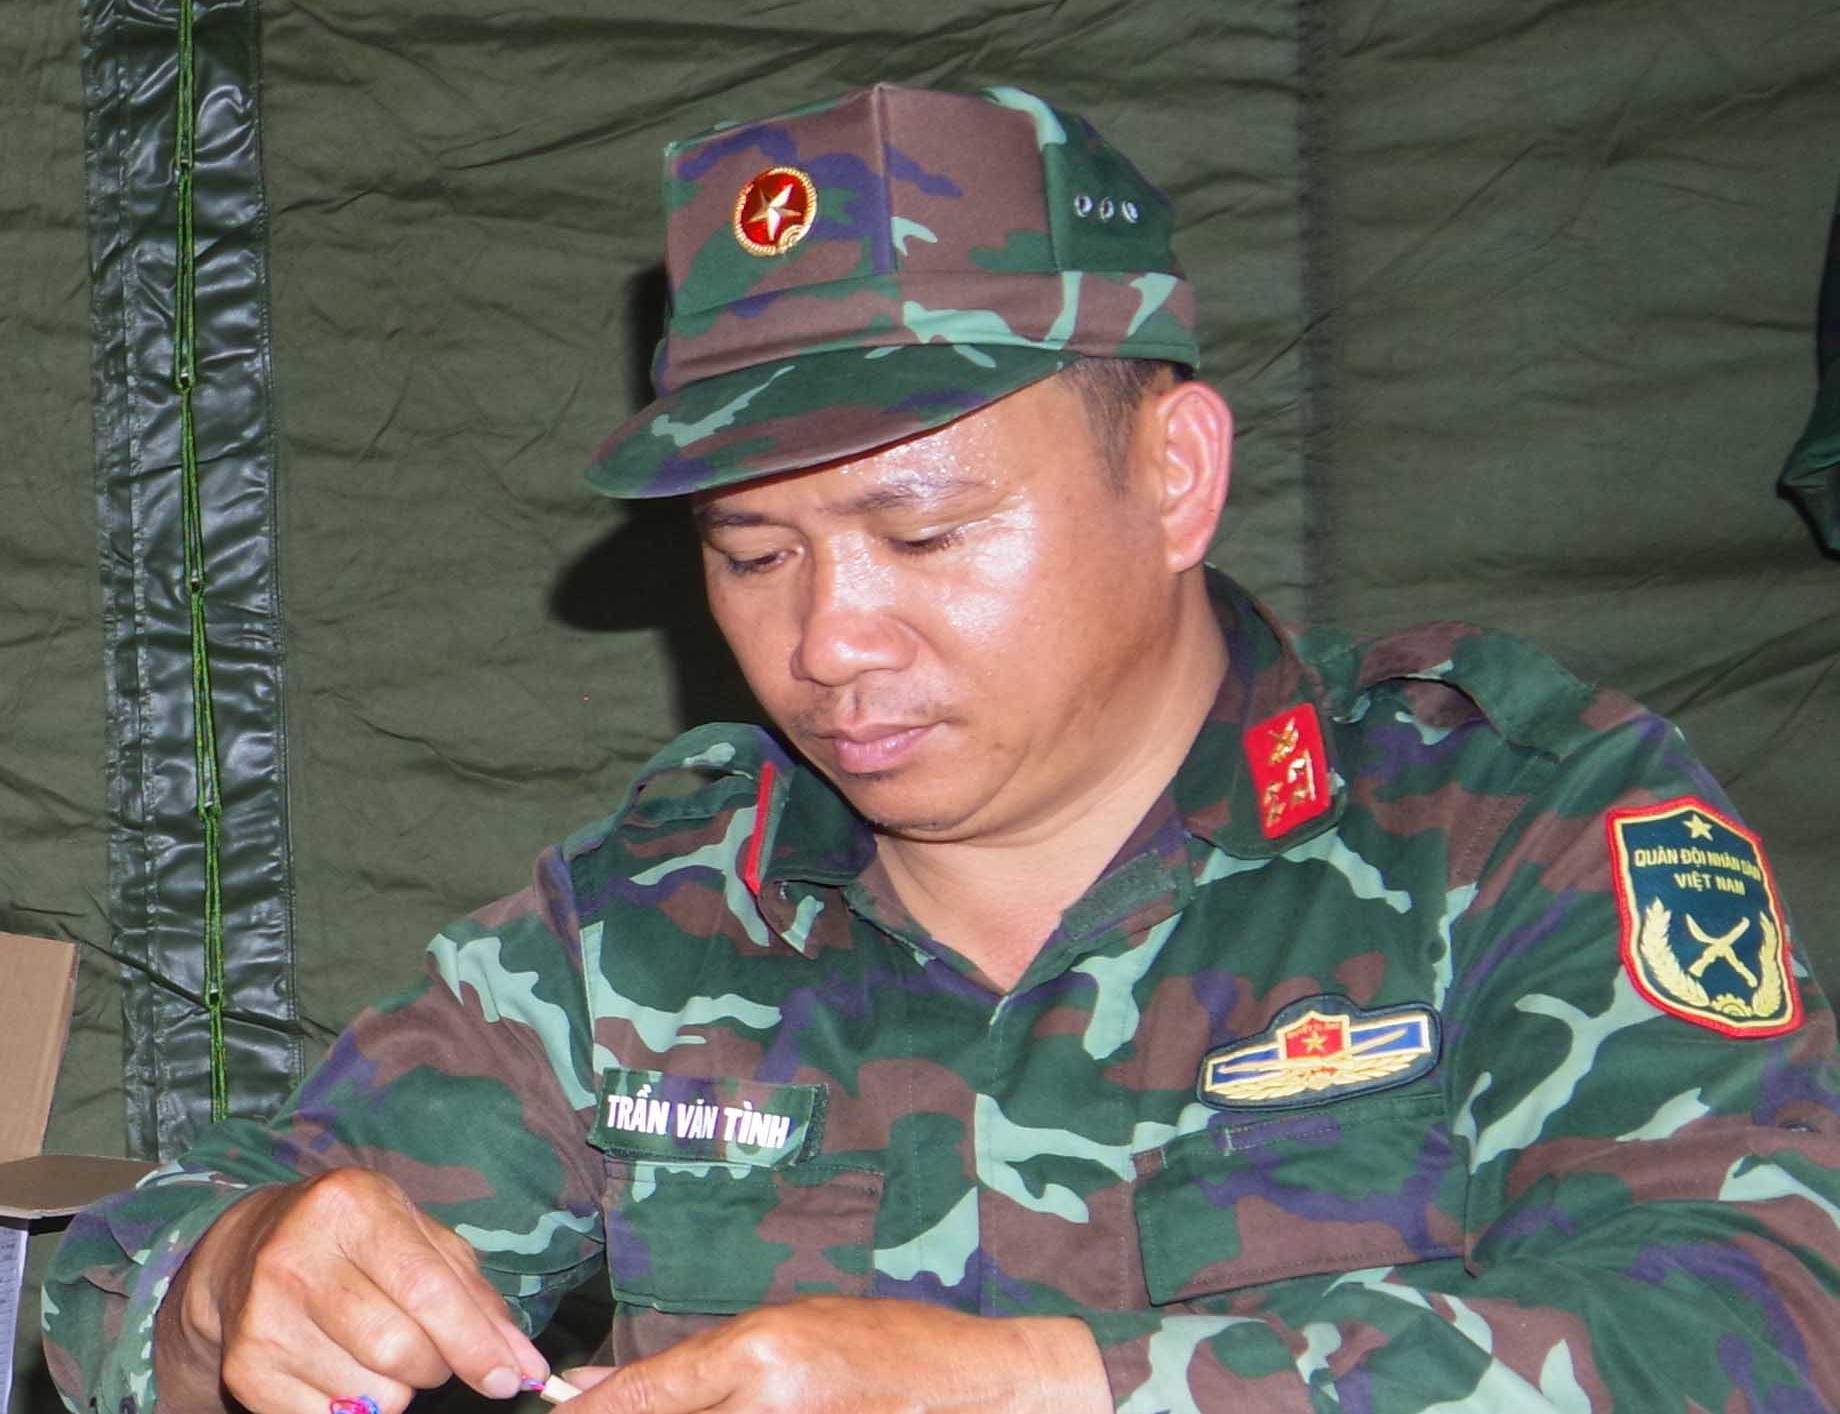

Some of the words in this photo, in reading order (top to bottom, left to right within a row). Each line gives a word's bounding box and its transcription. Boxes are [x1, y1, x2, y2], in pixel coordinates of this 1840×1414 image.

[1680, 846, 1706, 868] ĐỘI
[1673, 870, 1711, 892] VIỆT
[1715, 875, 1746, 896] NAM
[607, 1084, 670, 1136] TRẦN
[676, 1099, 719, 1140] VĂN
[723, 1101, 791, 1149] TÌNH
